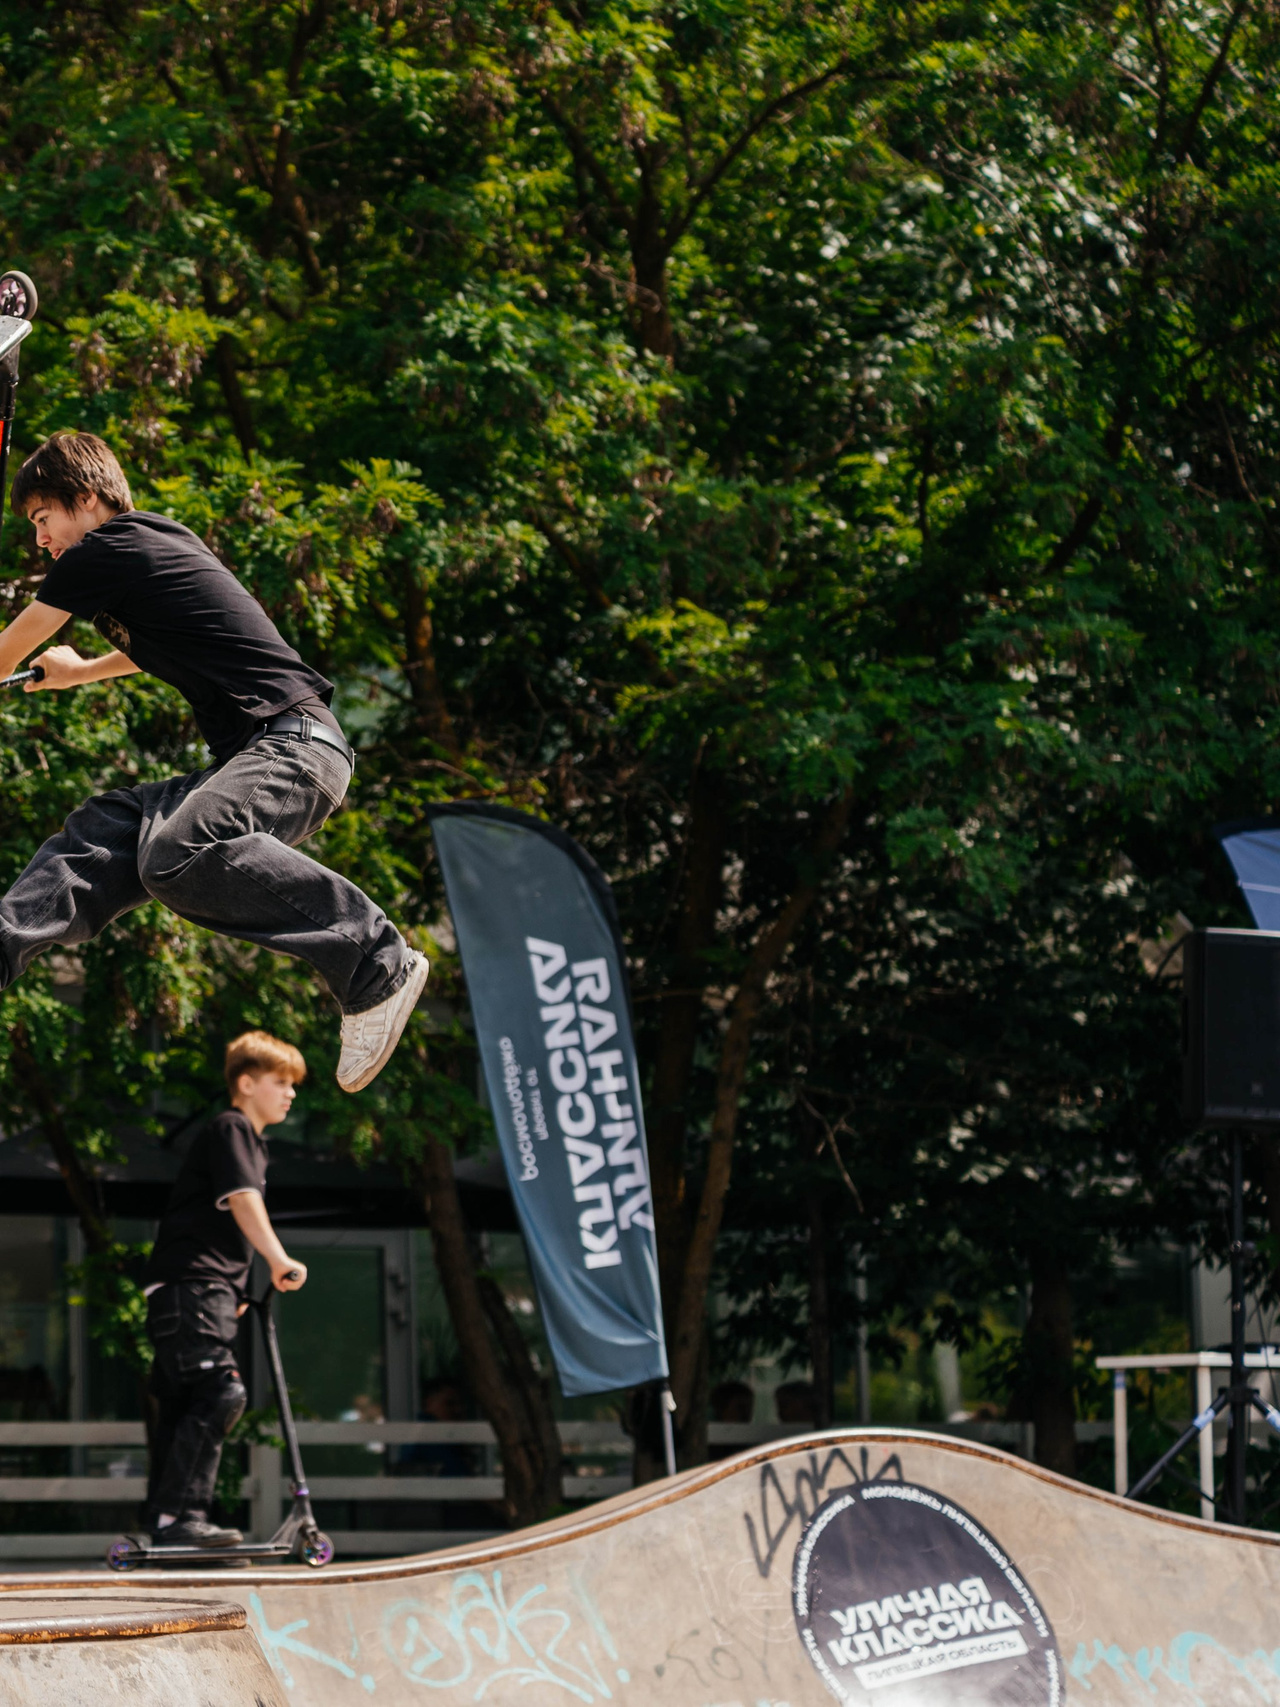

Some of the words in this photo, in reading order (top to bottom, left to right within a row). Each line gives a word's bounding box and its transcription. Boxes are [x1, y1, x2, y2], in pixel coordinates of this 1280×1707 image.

[941, 1503, 1008, 1571] ЛИПЕЦКОЙ
[1004, 1566, 1049, 1638] ОБЛАСТИ
[827, 1600, 1025, 1666] КЛАССИКА
[830, 1577, 992, 1636] УЛИЧНАЯ
